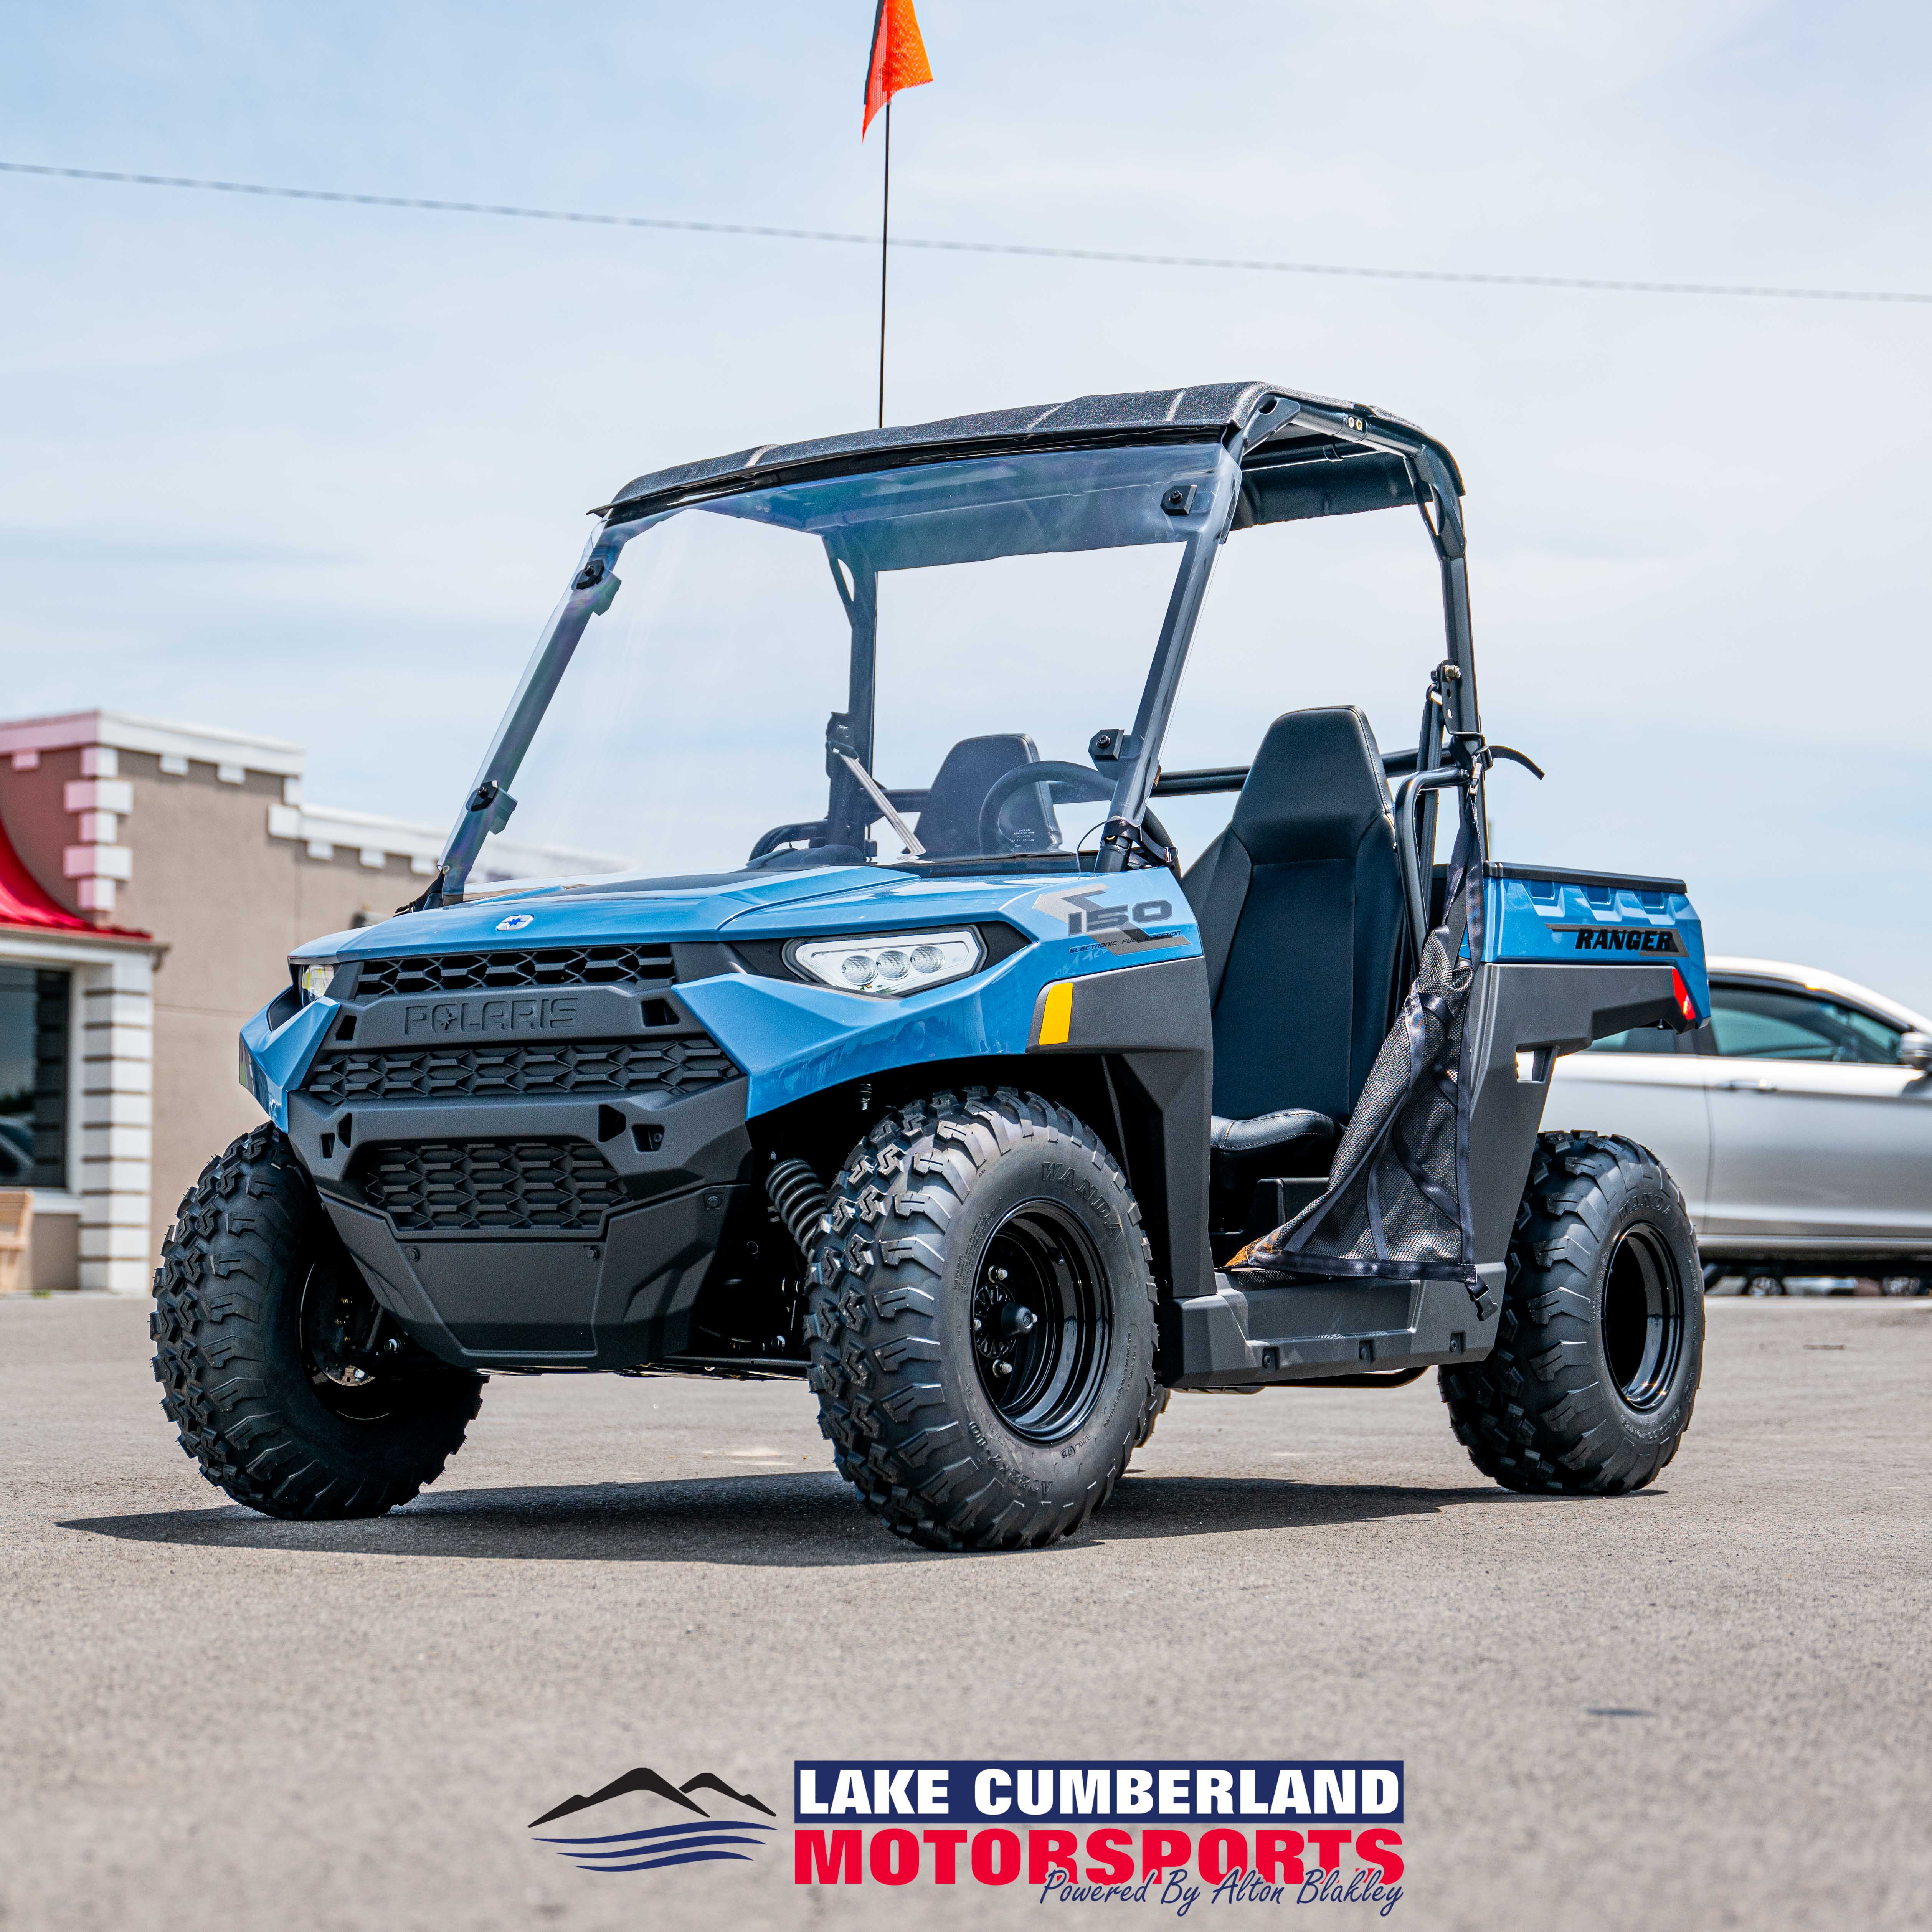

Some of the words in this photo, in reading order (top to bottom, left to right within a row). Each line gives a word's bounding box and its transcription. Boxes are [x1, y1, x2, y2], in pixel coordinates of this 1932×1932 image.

[1068, 899, 1173, 936] 150
[1070, 941, 1117, 953] ELECTRONIC
[1145, 930, 1181, 940] INJECTION
[1575, 928, 1673, 951] RANGER
[404, 997, 579, 1036] POLARIS
[1042, 1161, 1122, 1243] WANDA
